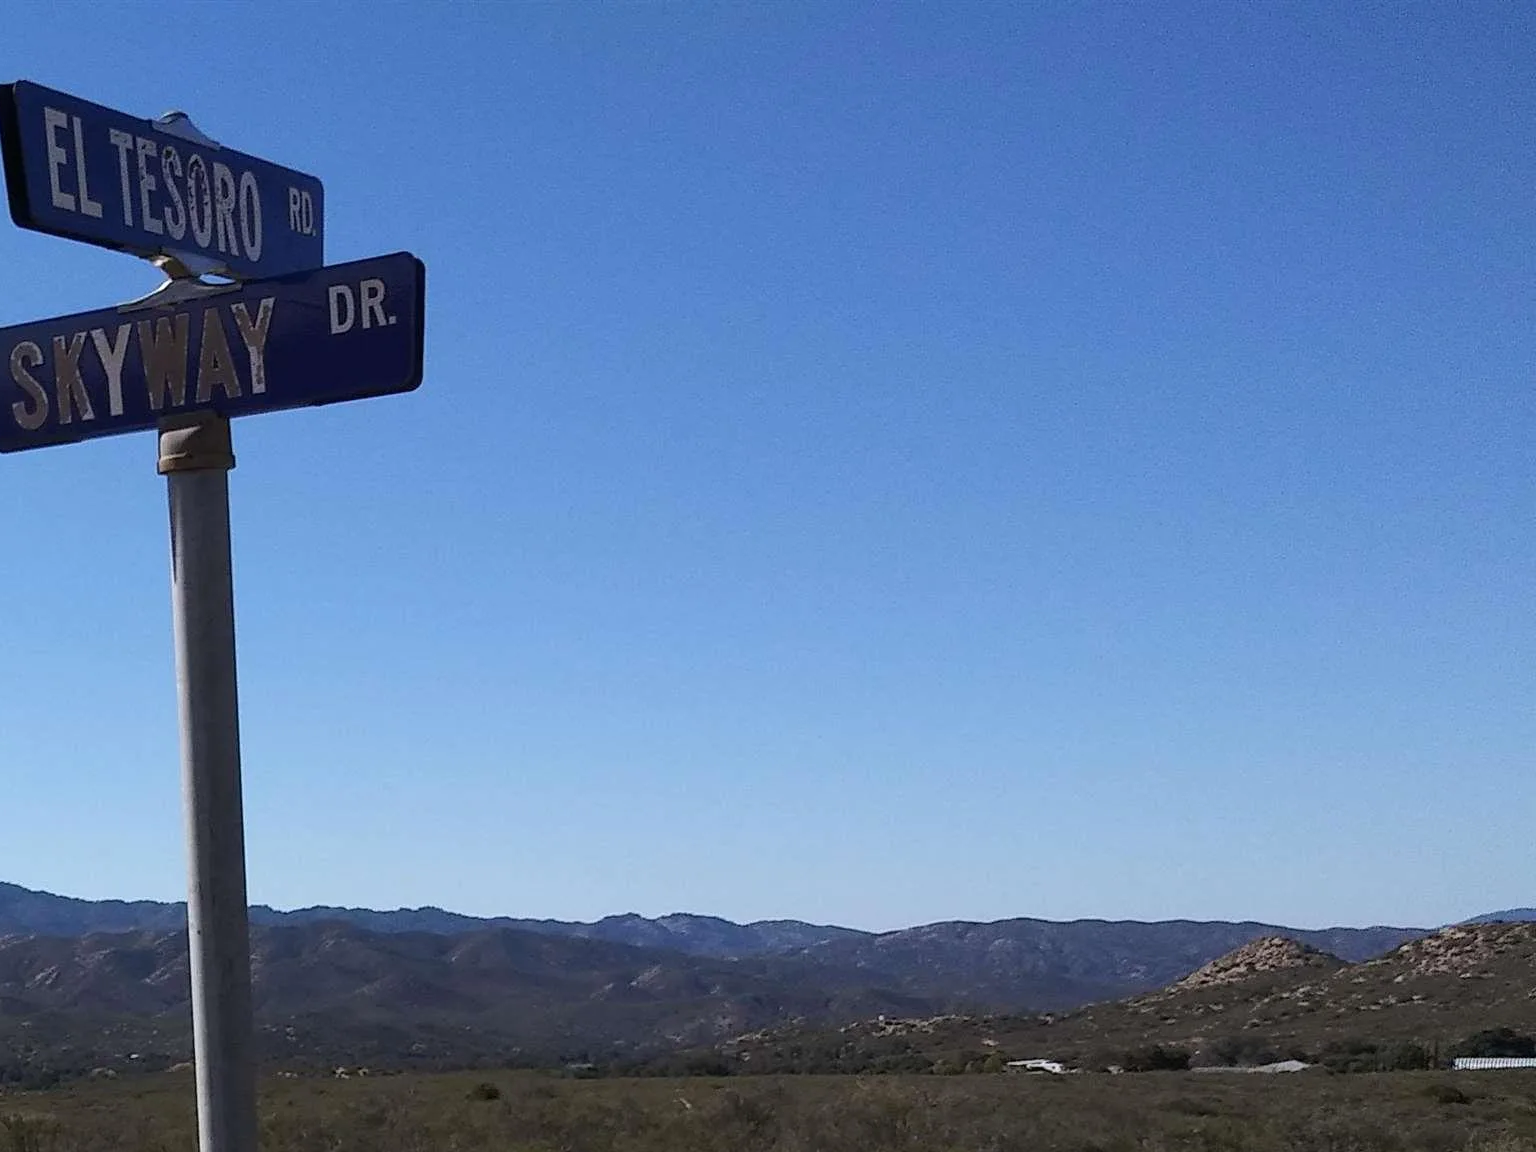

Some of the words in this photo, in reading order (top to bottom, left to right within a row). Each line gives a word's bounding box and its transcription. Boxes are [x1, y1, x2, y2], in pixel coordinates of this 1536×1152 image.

[43, 105, 103, 219] EL
[109, 128, 263, 263] TESORO
[288, 187, 317, 237] RD.
[9, 296, 276, 431] SKYWAY
[327, 278, 397, 336] DR.
